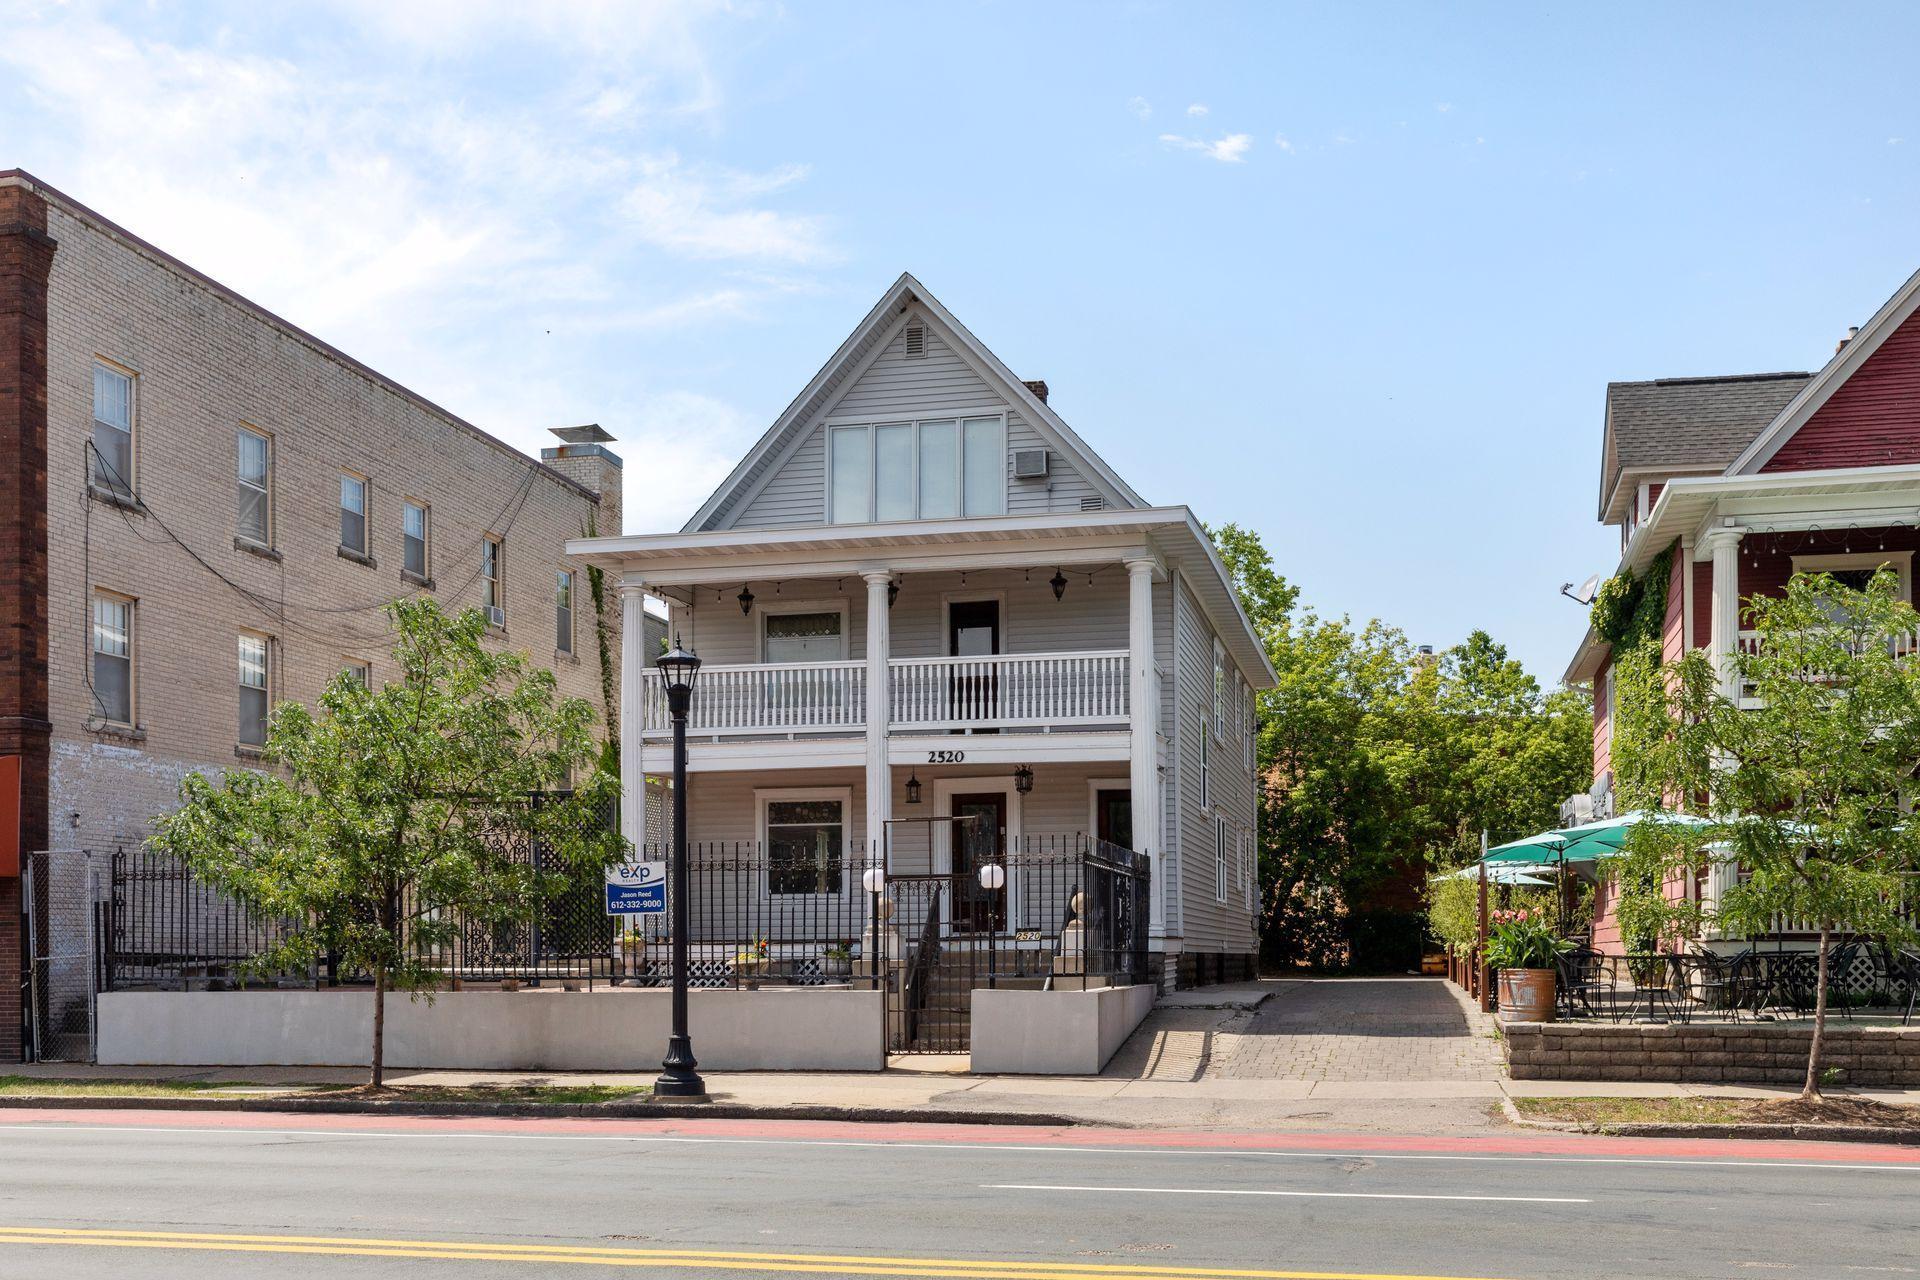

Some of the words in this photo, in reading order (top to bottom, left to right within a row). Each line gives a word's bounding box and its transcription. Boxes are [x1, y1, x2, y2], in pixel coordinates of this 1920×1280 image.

[928, 750, 965, 763] 2520
[611, 900, 662, 909] 612-332-9000
[1016, 931, 1041, 941] 2520
